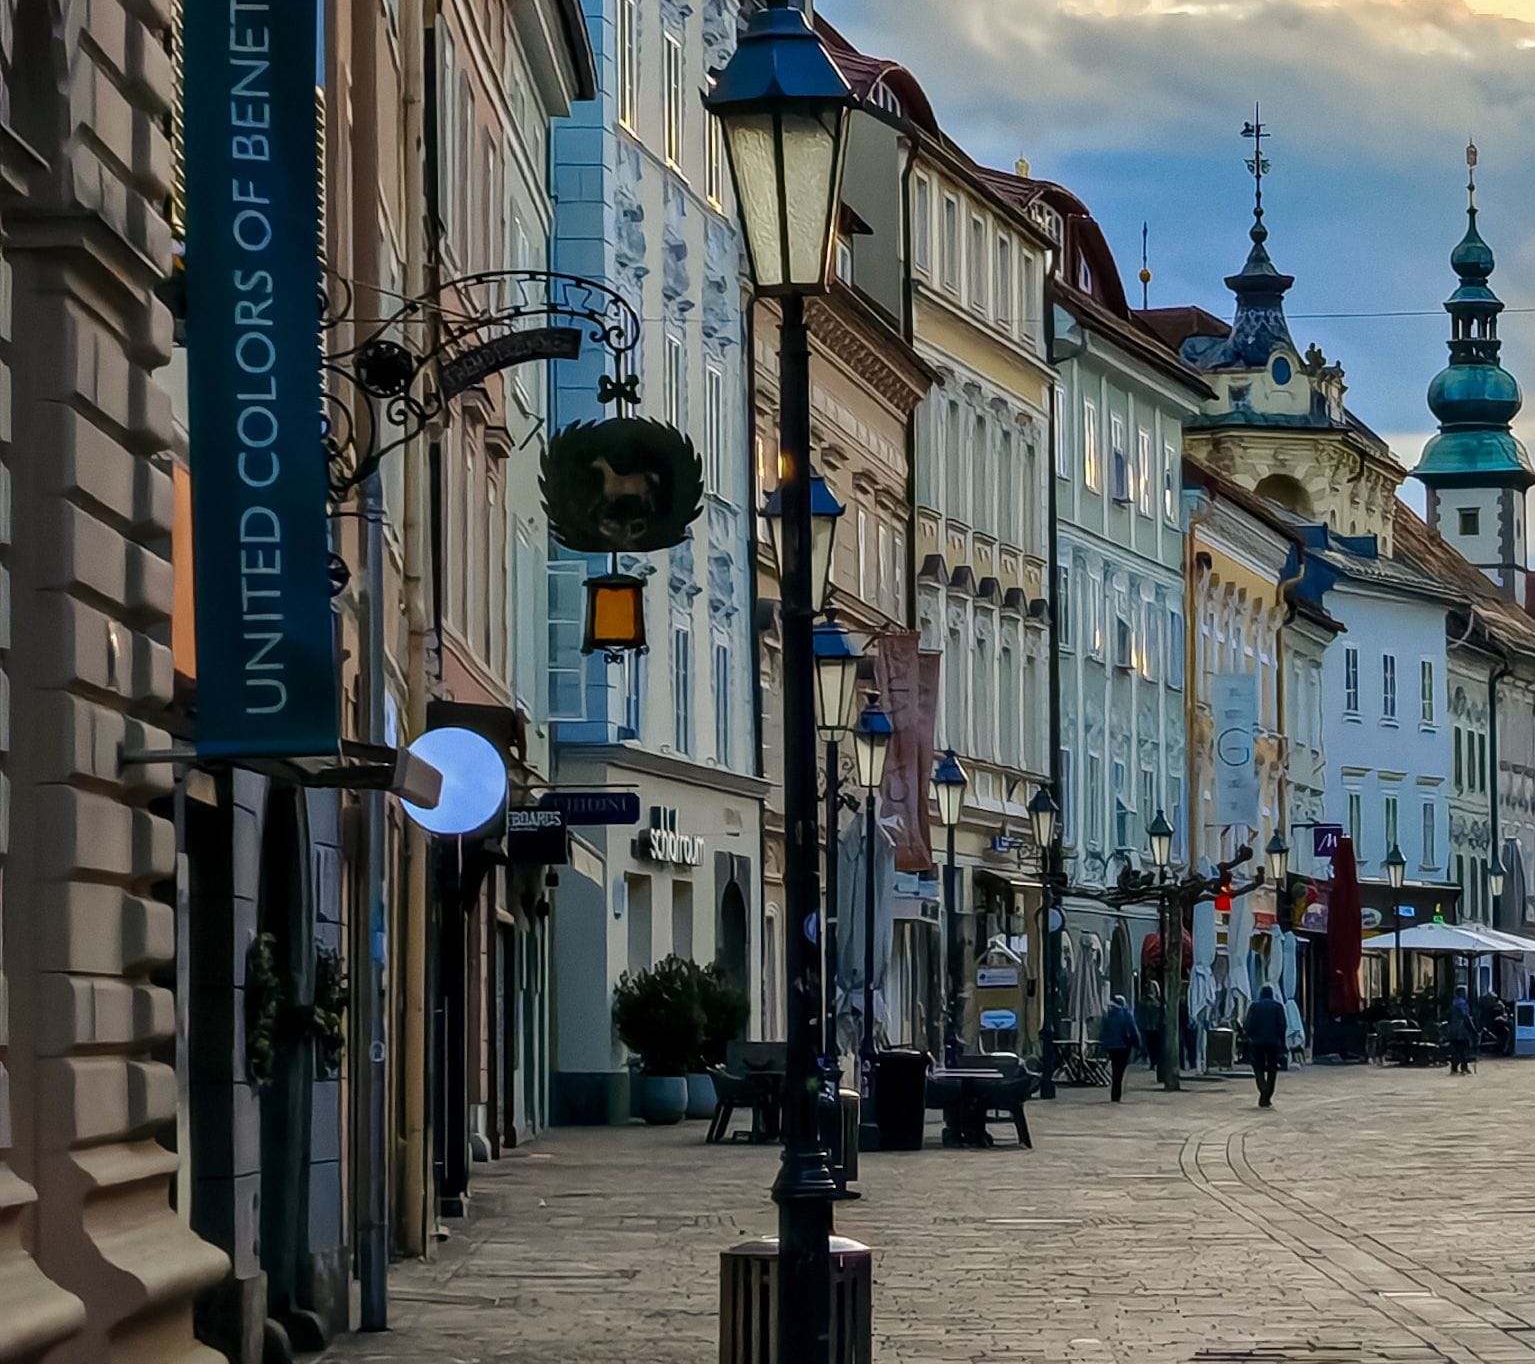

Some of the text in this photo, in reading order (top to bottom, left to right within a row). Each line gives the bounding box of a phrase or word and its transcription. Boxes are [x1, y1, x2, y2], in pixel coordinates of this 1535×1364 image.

[232, 178, 271, 252] OF
[233, 268, 280, 488] COLORS
[239, 504, 287, 715] UNITED
